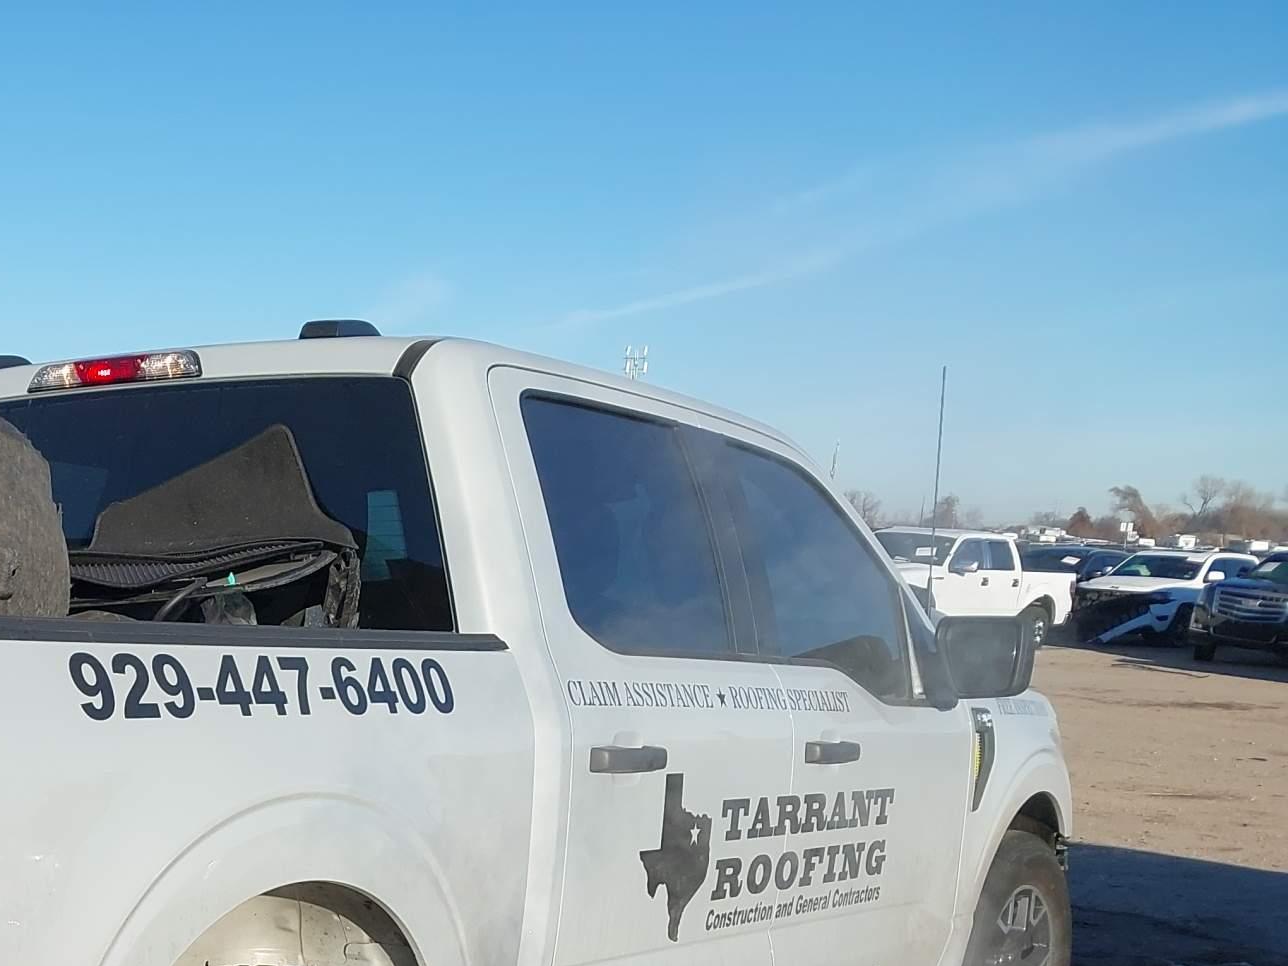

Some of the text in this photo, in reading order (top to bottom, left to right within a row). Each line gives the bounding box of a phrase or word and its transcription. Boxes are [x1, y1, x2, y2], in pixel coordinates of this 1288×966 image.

[68, 652, 454, 721] 929-447-6400
[567, 680, 850, 713] CLAIM ASSISTANCE ROOFING SPECIALIST
[721, 788, 895, 841] TARRANT
[710, 839, 887, 901] ROOFING
[705, 885, 882, 931] Construction and General Contractors
